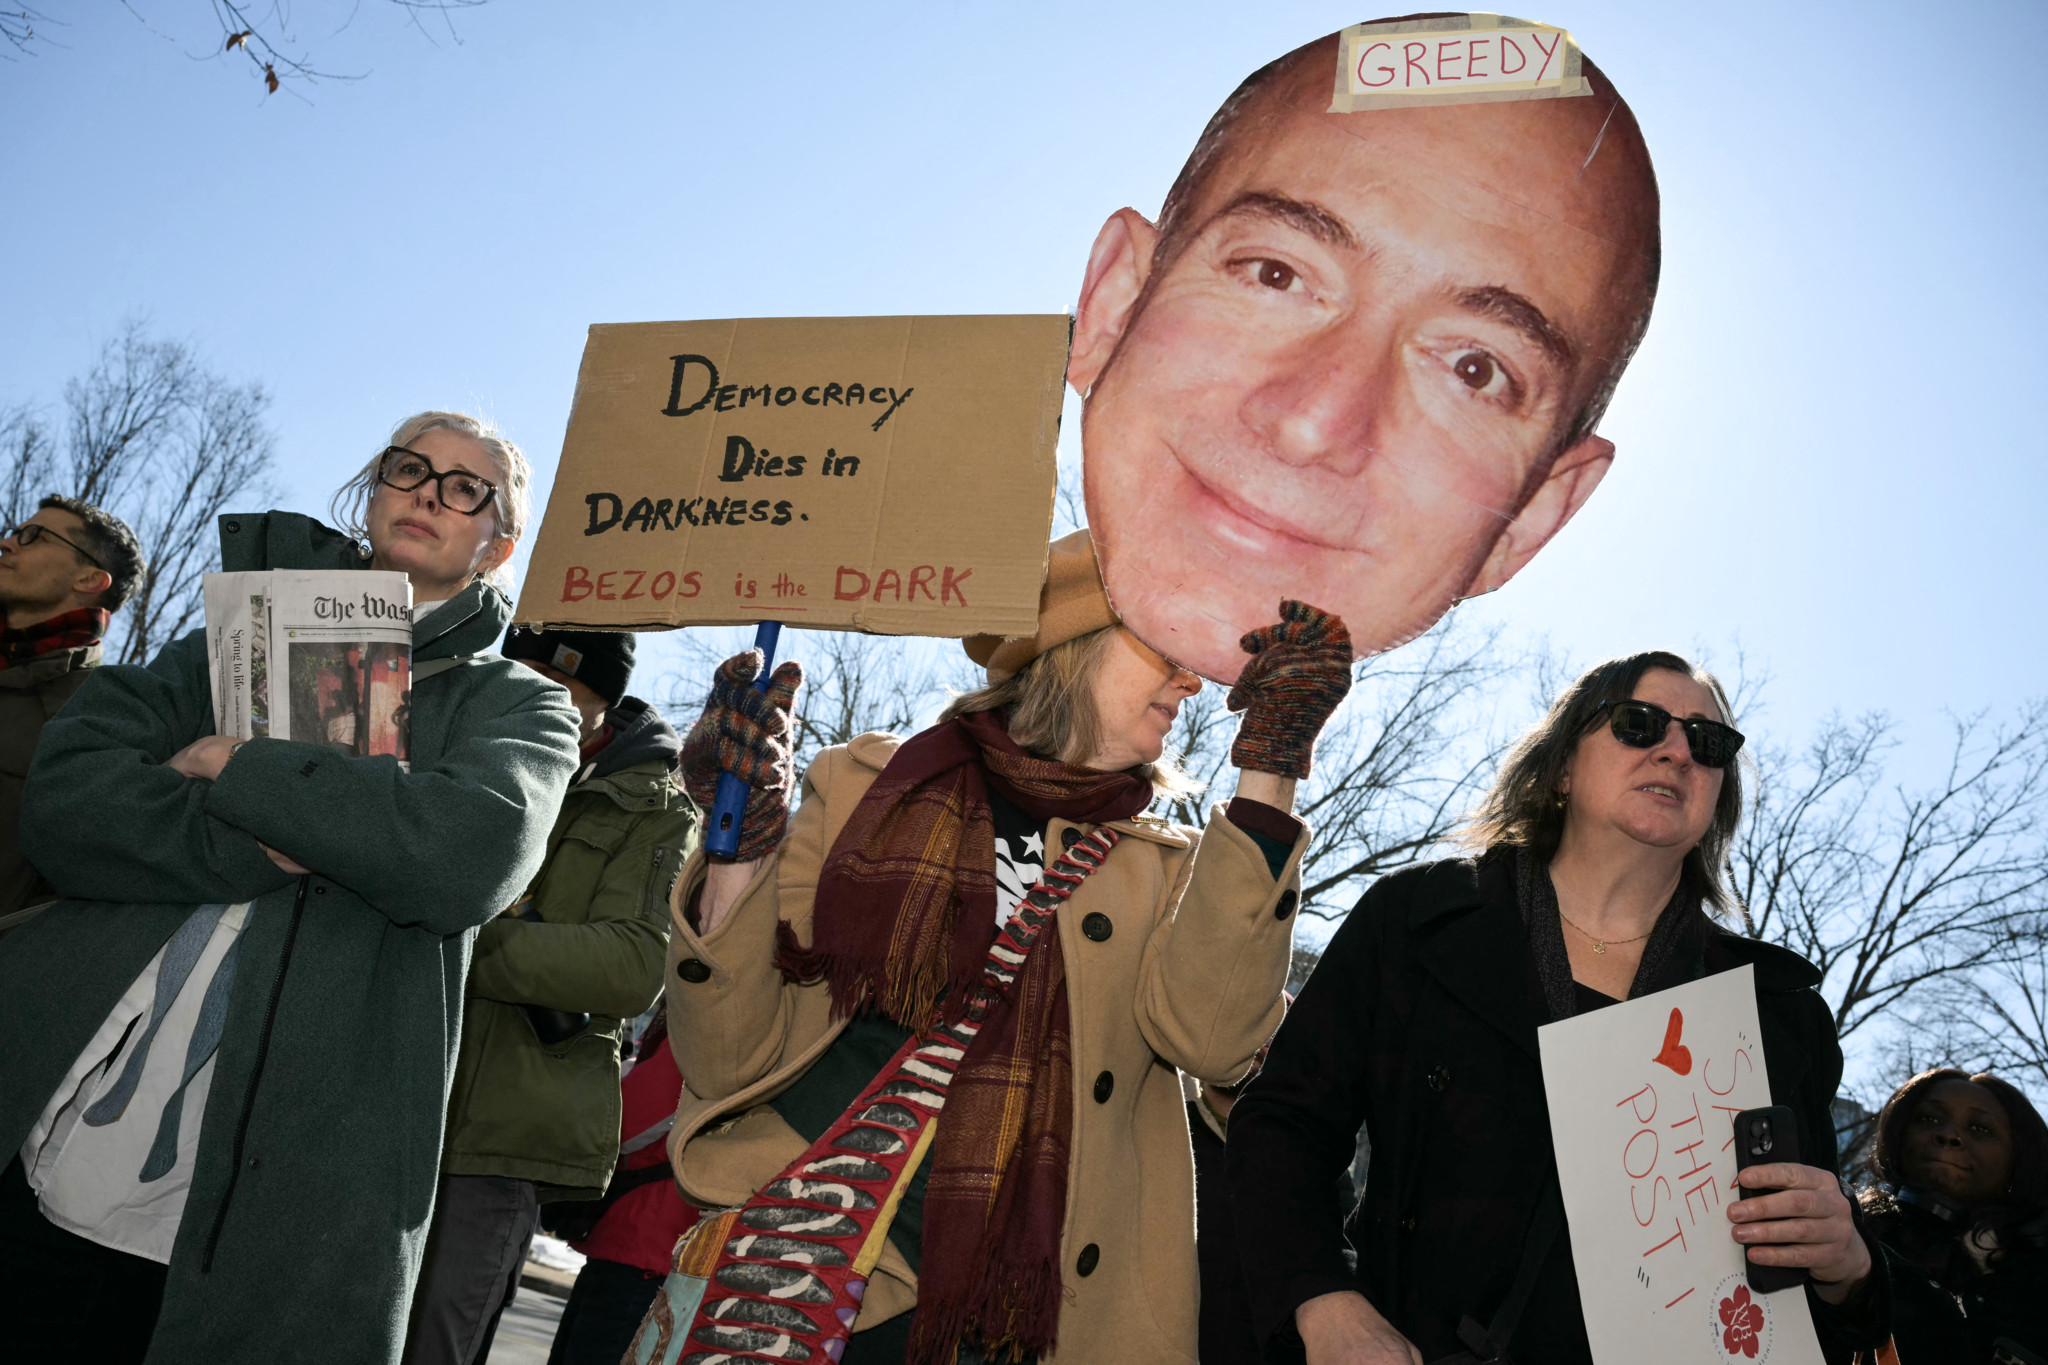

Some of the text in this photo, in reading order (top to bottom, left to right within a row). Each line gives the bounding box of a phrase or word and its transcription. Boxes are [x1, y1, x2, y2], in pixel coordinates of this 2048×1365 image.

[1357, 32, 1561, 87] GREEDY
[719, 435, 861, 482] Dies in
[560, 565, 973, 608] BEZOS is the DARK
[313, 596, 356, 624] The
[230, 629, 245, 661] Spring
[233, 663, 243, 673] to
[233, 675, 245, 691] life
[1703, 1049, 1753, 1190] SA
[1671, 1092, 1720, 1226] THE
